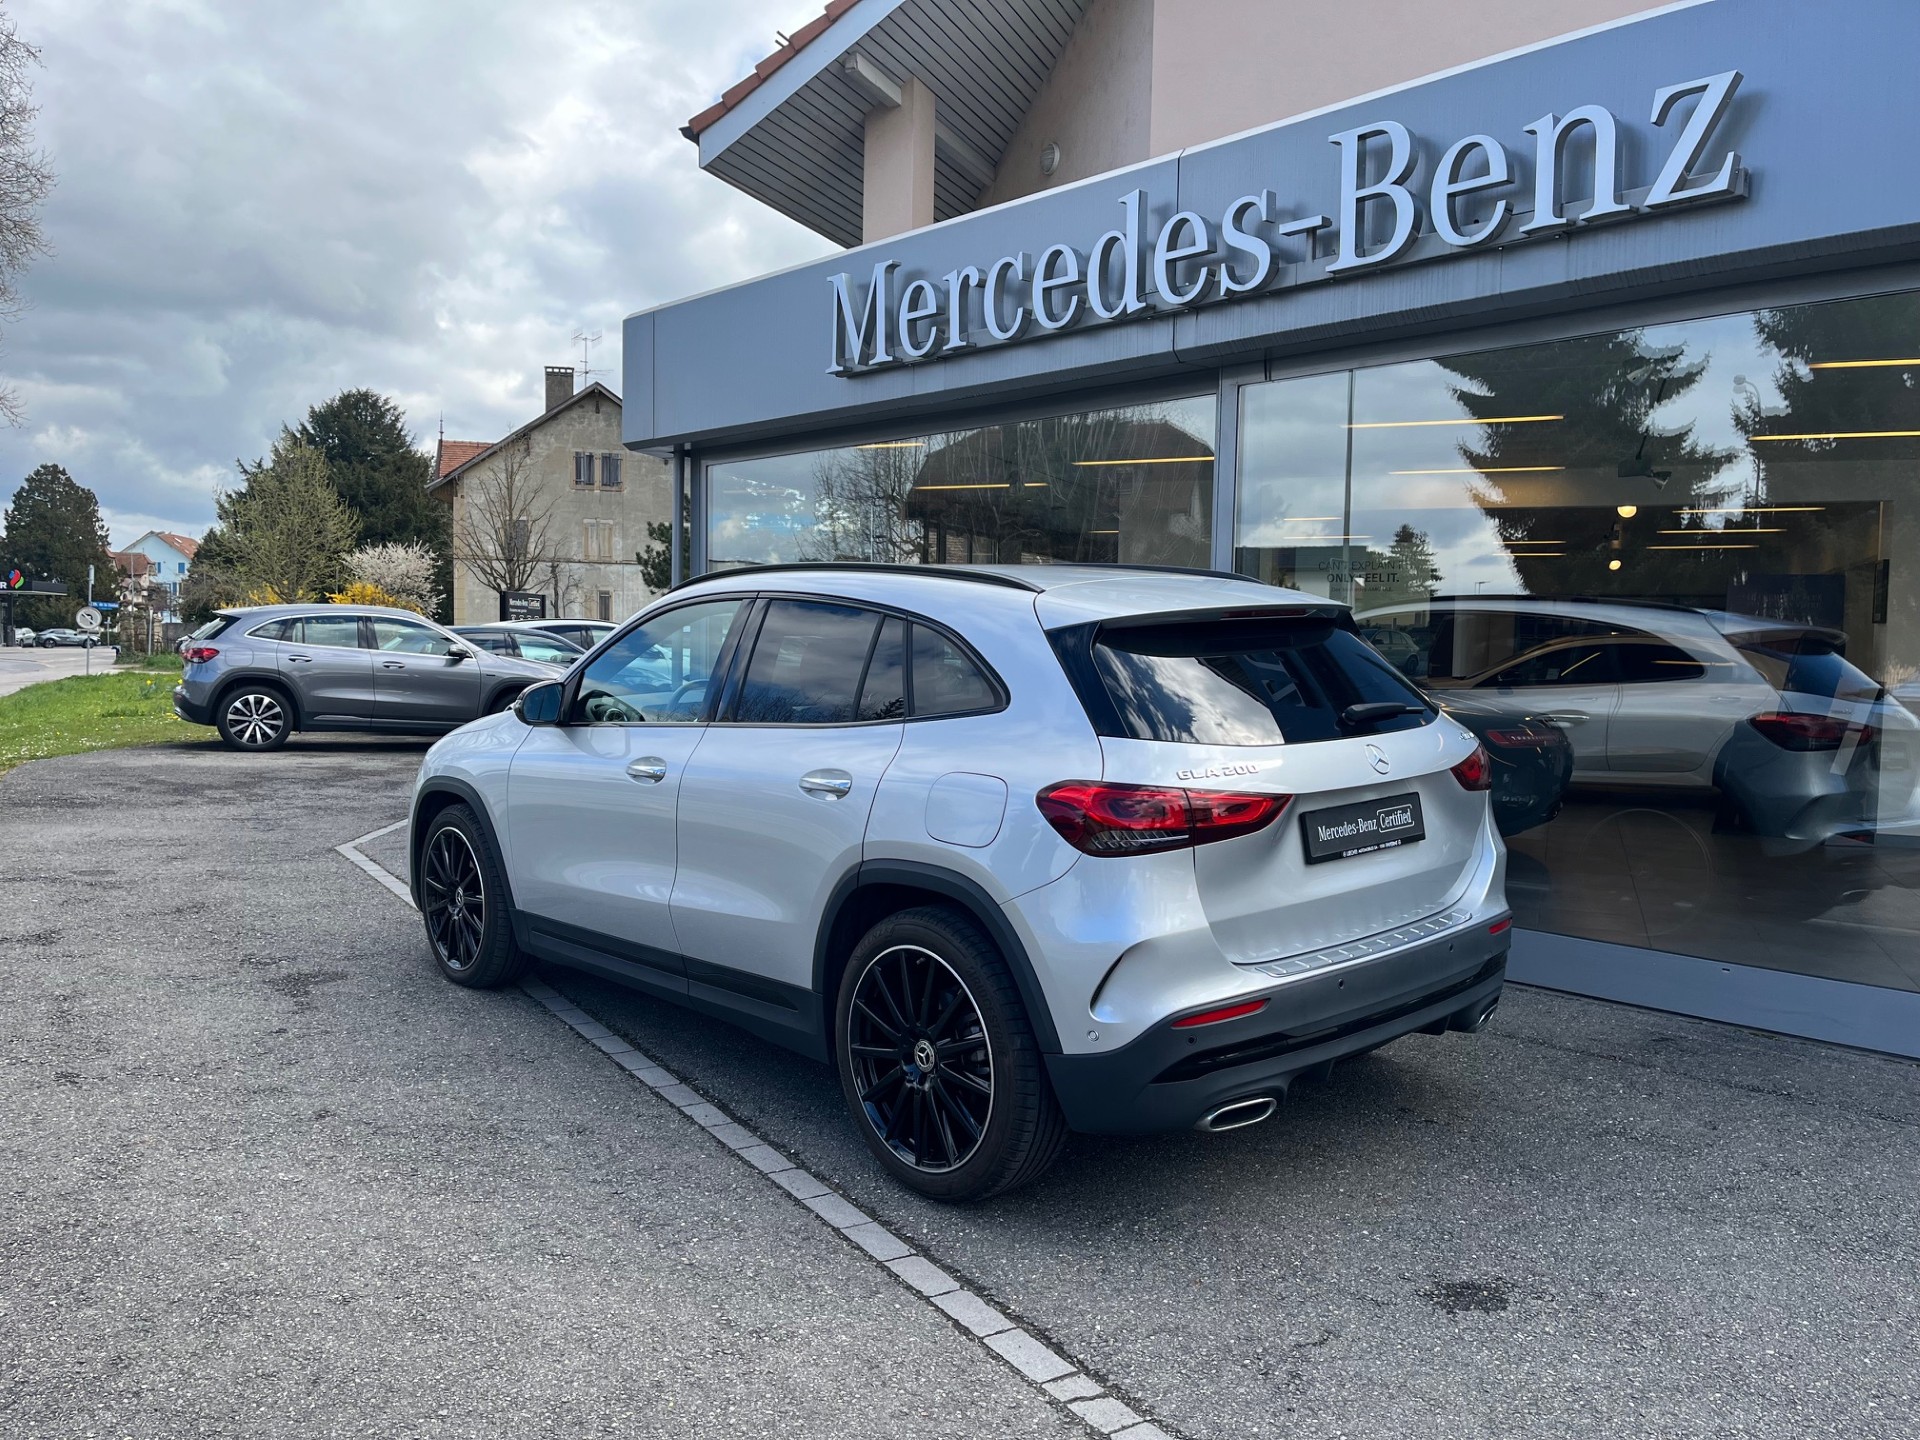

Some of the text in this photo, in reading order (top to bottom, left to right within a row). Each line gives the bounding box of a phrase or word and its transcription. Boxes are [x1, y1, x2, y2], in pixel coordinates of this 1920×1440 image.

[826, 69, 1748, 379] Mercedes-Benz
[1351, 560, 1395, 570] EXPLAIN
[1327, 572, 1354, 582] ONLY
[1176, 764, 1260, 781] GLA 200
[1317, 809, 1412, 842] Mercedes-Benz Certified
